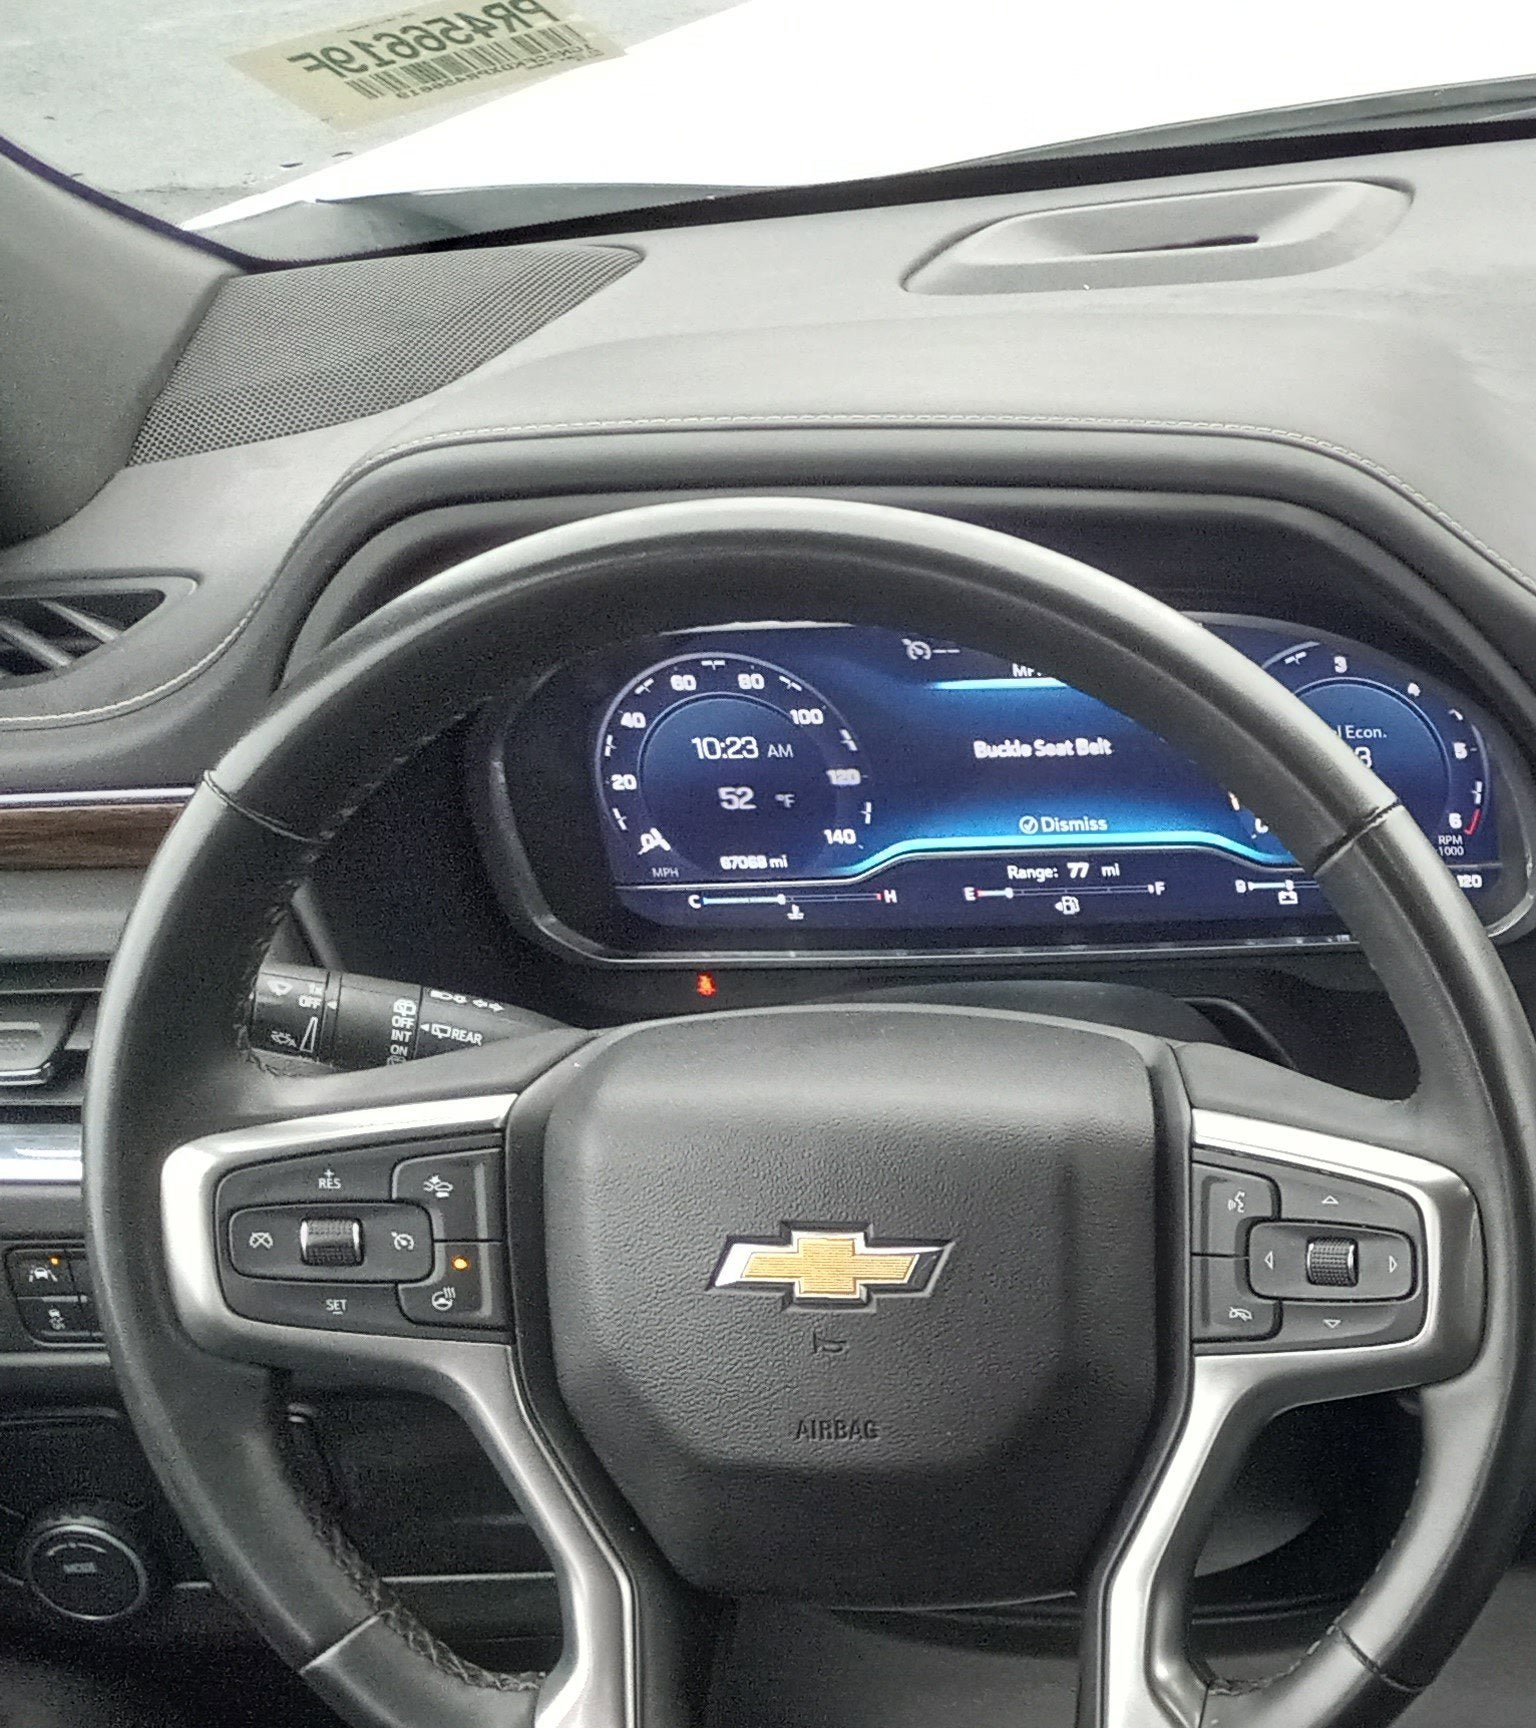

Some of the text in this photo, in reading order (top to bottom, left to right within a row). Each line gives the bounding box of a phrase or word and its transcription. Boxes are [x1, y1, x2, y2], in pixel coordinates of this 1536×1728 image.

[1334, 655, 1347, 673] 3
[670, 674, 697, 691] 60
[738, 673, 765, 690] 80
[620, 711, 646, 729] 40
[790, 708, 824, 725] 100
[1345, 725, 1387, 739] Econ.
[691, 736, 794, 760] 10:23 AM
[973, 737, 1112, 758] Buckle Seat Belt
[1453, 741, 1468, 760] 5
[611, 774, 637, 791] 20
[826, 768, 862, 785] 120
[717, 787, 757, 810] 52
[1041, 816, 1108, 833] Dismiss
[1448, 812, 1462, 829] 6
[824, 828, 857, 845] 140
[1438, 835, 1463, 846] RPM
[769, 855, 789, 869] mi
[652, 866, 679, 878] MPH
[1007, 862, 1120, 883] Range: 77 mi
[688, 895, 701, 909] C
[884, 889, 898, 903] H
[299, 995, 323, 1009] OFF
[391, 1015, 415, 1028] OFF
[391, 1030, 413, 1042] INT
[452, 1028, 483, 1047] REAR
[390, 1044, 408, 1056] ON
[318, 1177, 342, 1190] RES
[326, 1299, 347, 1312] SET
[796, 1419, 880, 1440] AIRBAG
